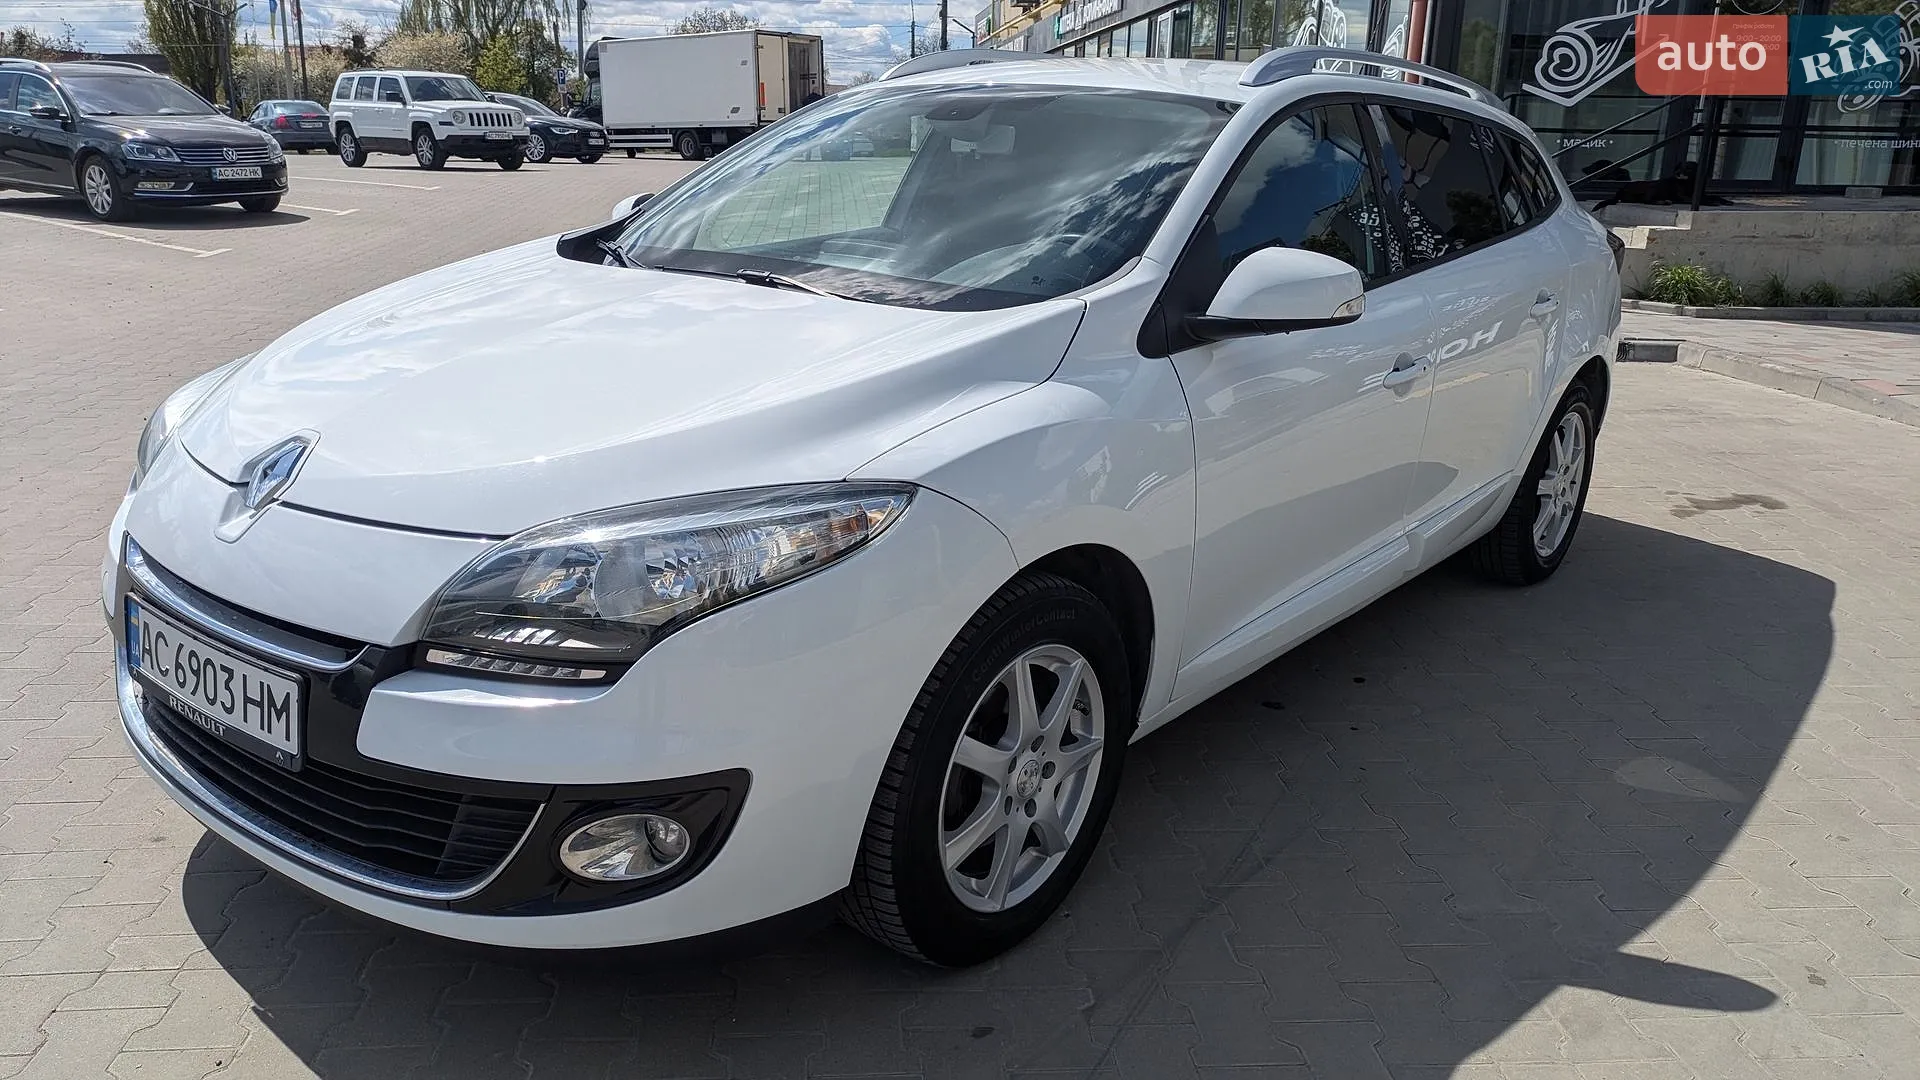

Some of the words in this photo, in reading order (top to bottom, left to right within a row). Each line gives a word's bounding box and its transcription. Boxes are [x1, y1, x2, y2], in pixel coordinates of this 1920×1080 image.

[1841, 139, 1888, 148] печена
[218, 169, 230, 178] AC
[231, 168, 249, 178] 2472
[249, 168, 261, 177] HK
[141, 620, 170, 678] AC
[174, 642, 236, 716] 6903
[242, 673, 291, 743] HM
[169, 694, 227, 738] RENAULT
